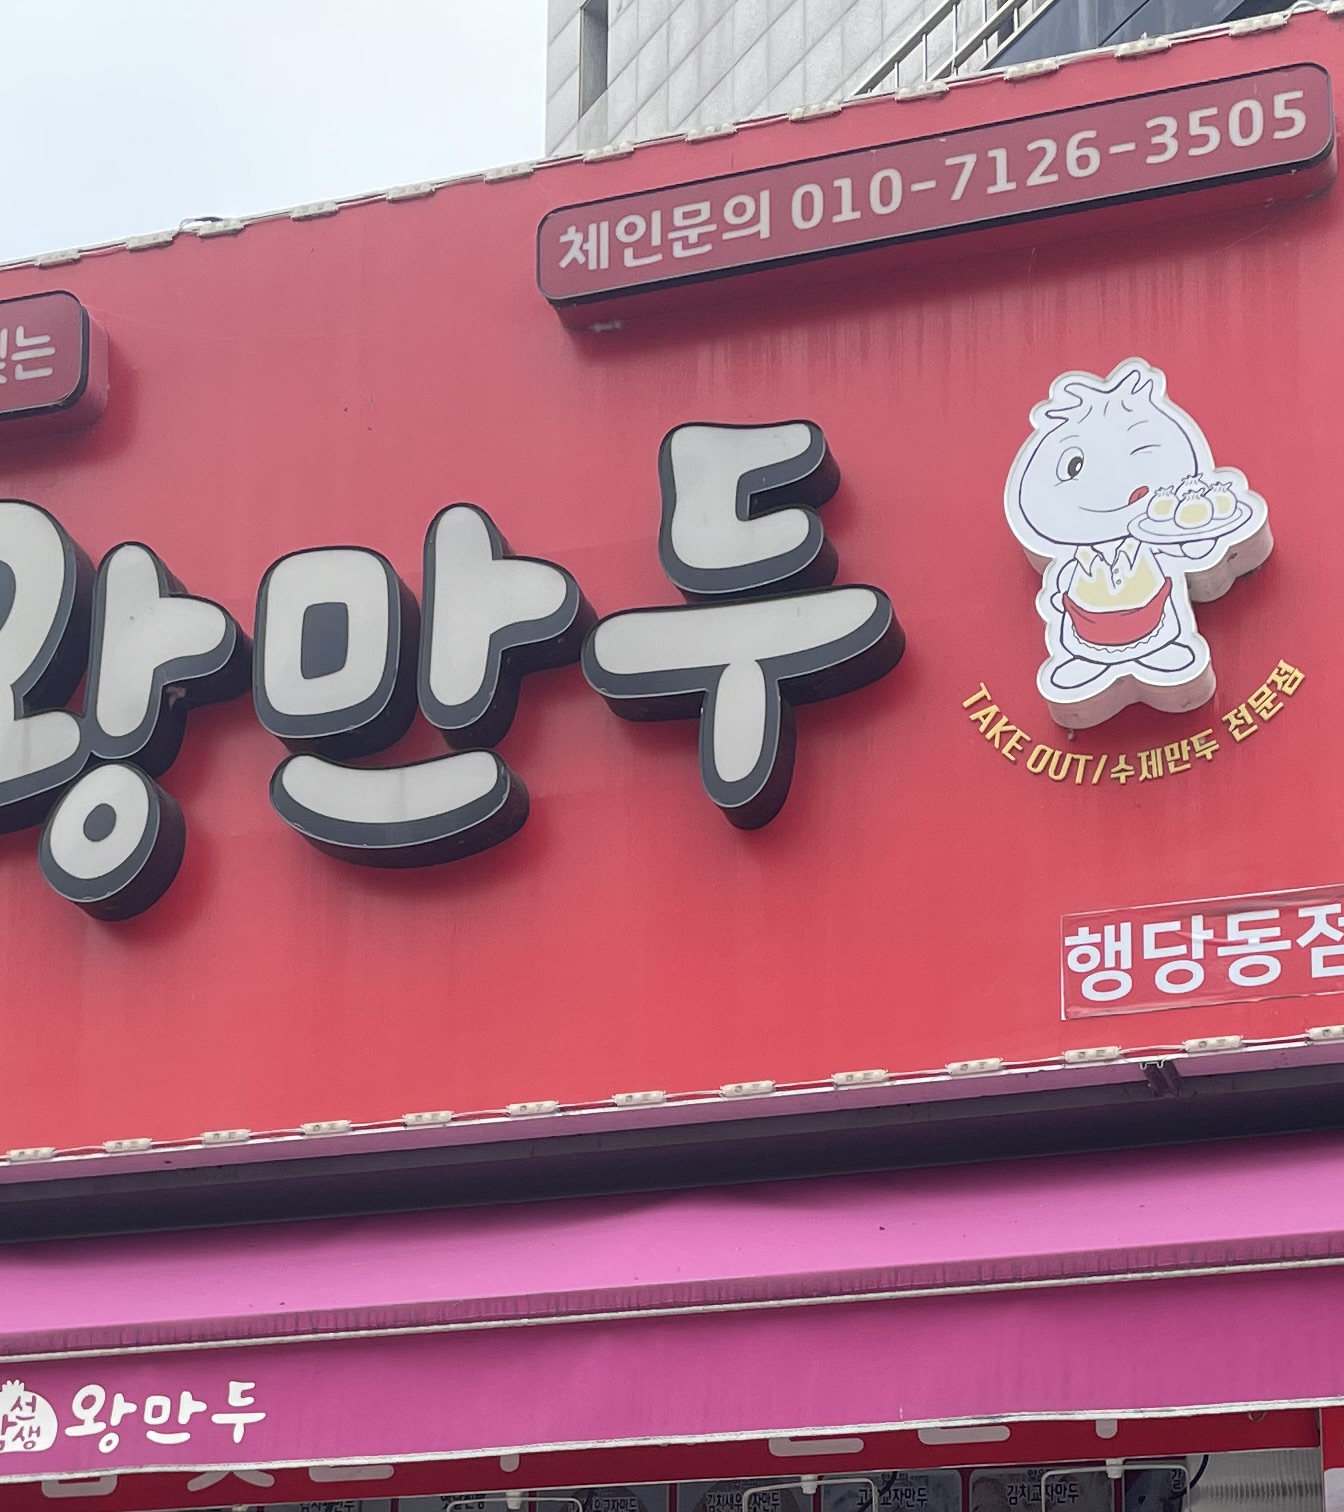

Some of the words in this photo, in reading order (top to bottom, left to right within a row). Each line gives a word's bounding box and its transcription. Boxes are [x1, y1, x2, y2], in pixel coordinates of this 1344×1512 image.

[557, 193, 774, 273] 체인문의
[790, 88, 1310, 231] 010-7126-3505
[962, 681, 1032, 762] TAKE
[1221, 659, 1307, 742] 전문점
[64, 1380, 266, 1453] 왕만두
